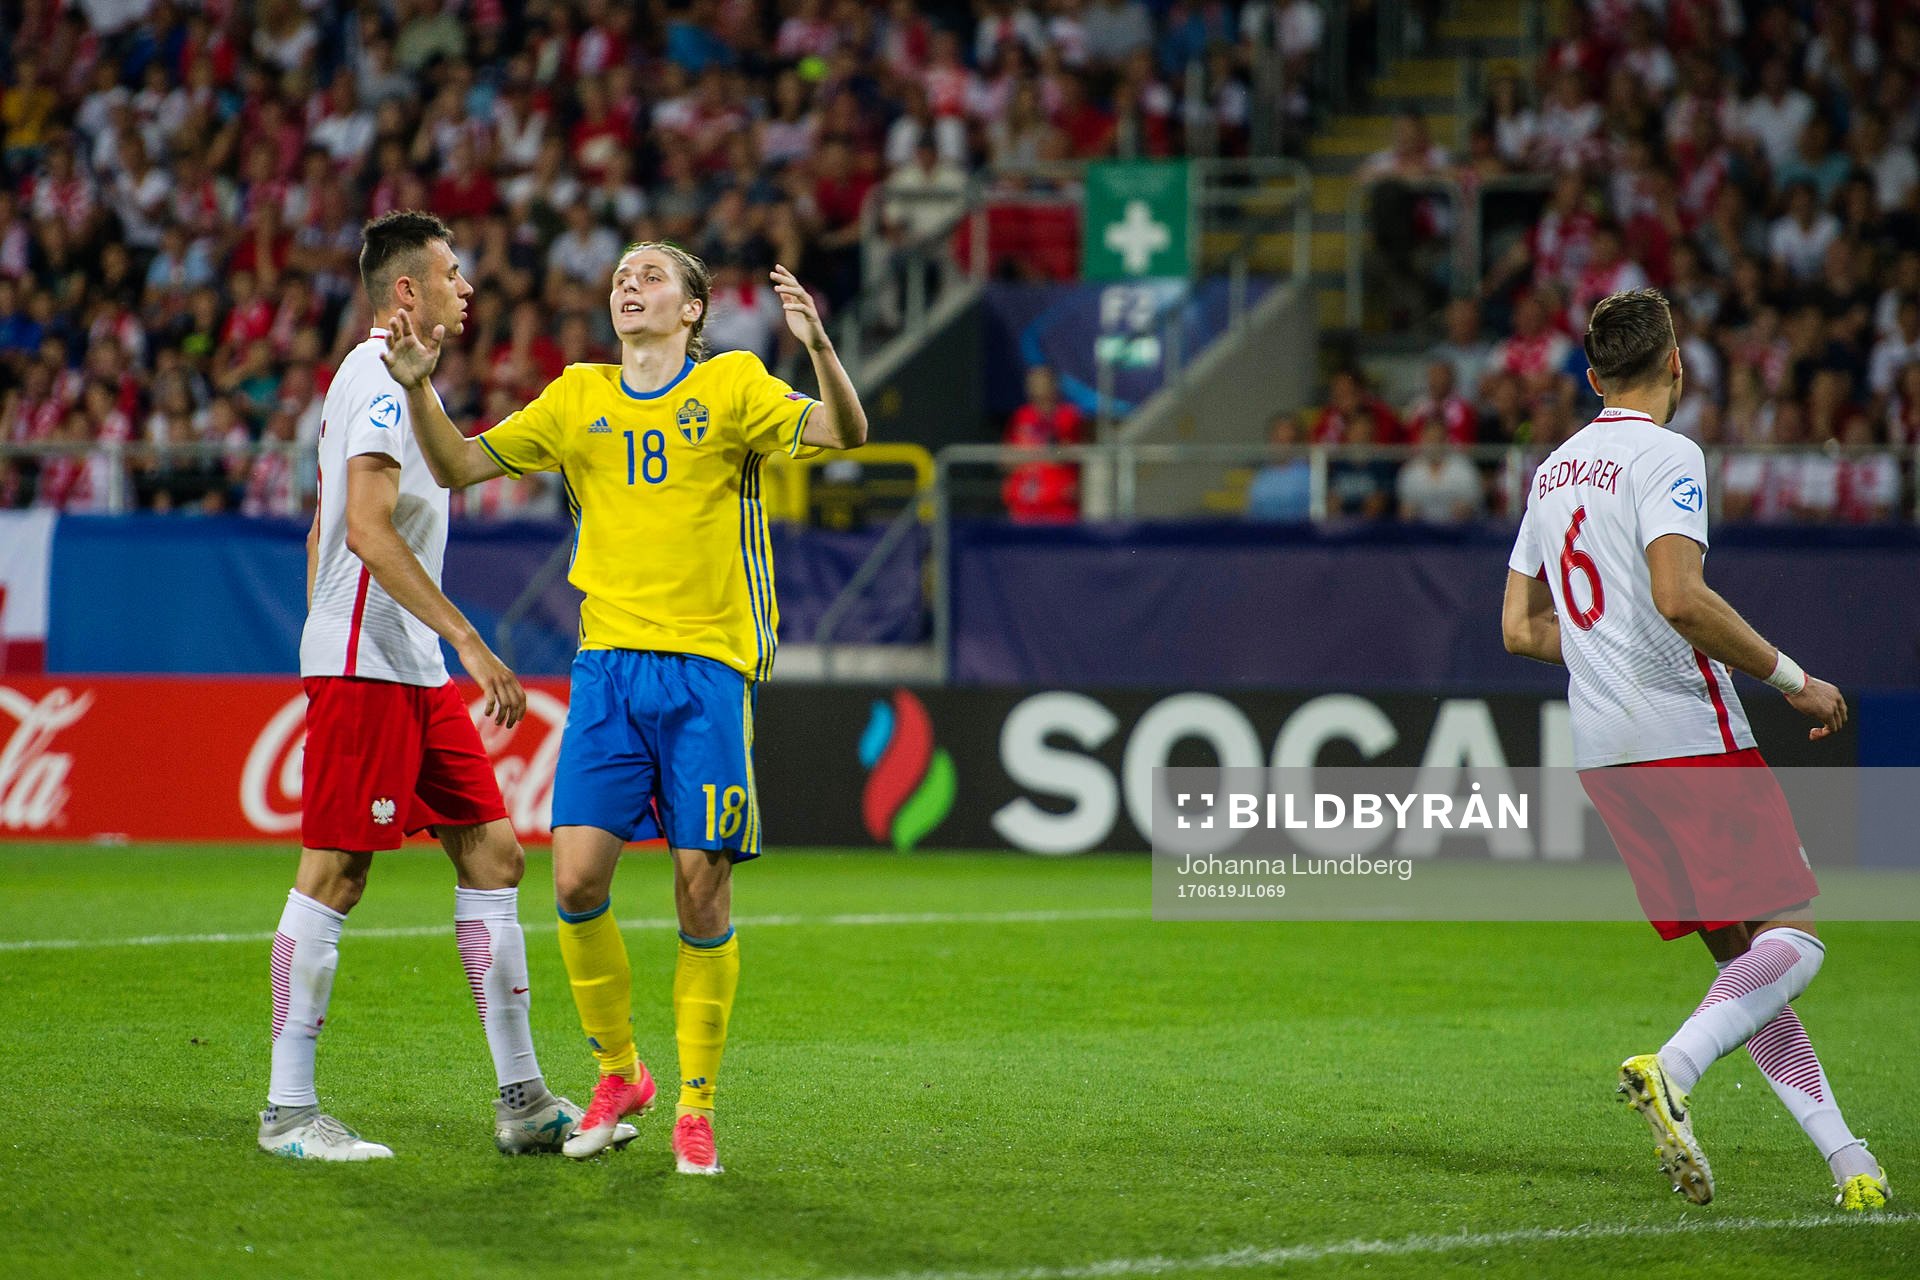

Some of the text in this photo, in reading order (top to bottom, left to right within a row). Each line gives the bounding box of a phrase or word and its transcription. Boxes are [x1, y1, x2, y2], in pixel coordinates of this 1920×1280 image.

[623, 429, 668, 485] 18
[1560, 505, 1605, 631] 6
[702, 784, 747, 841] 18
